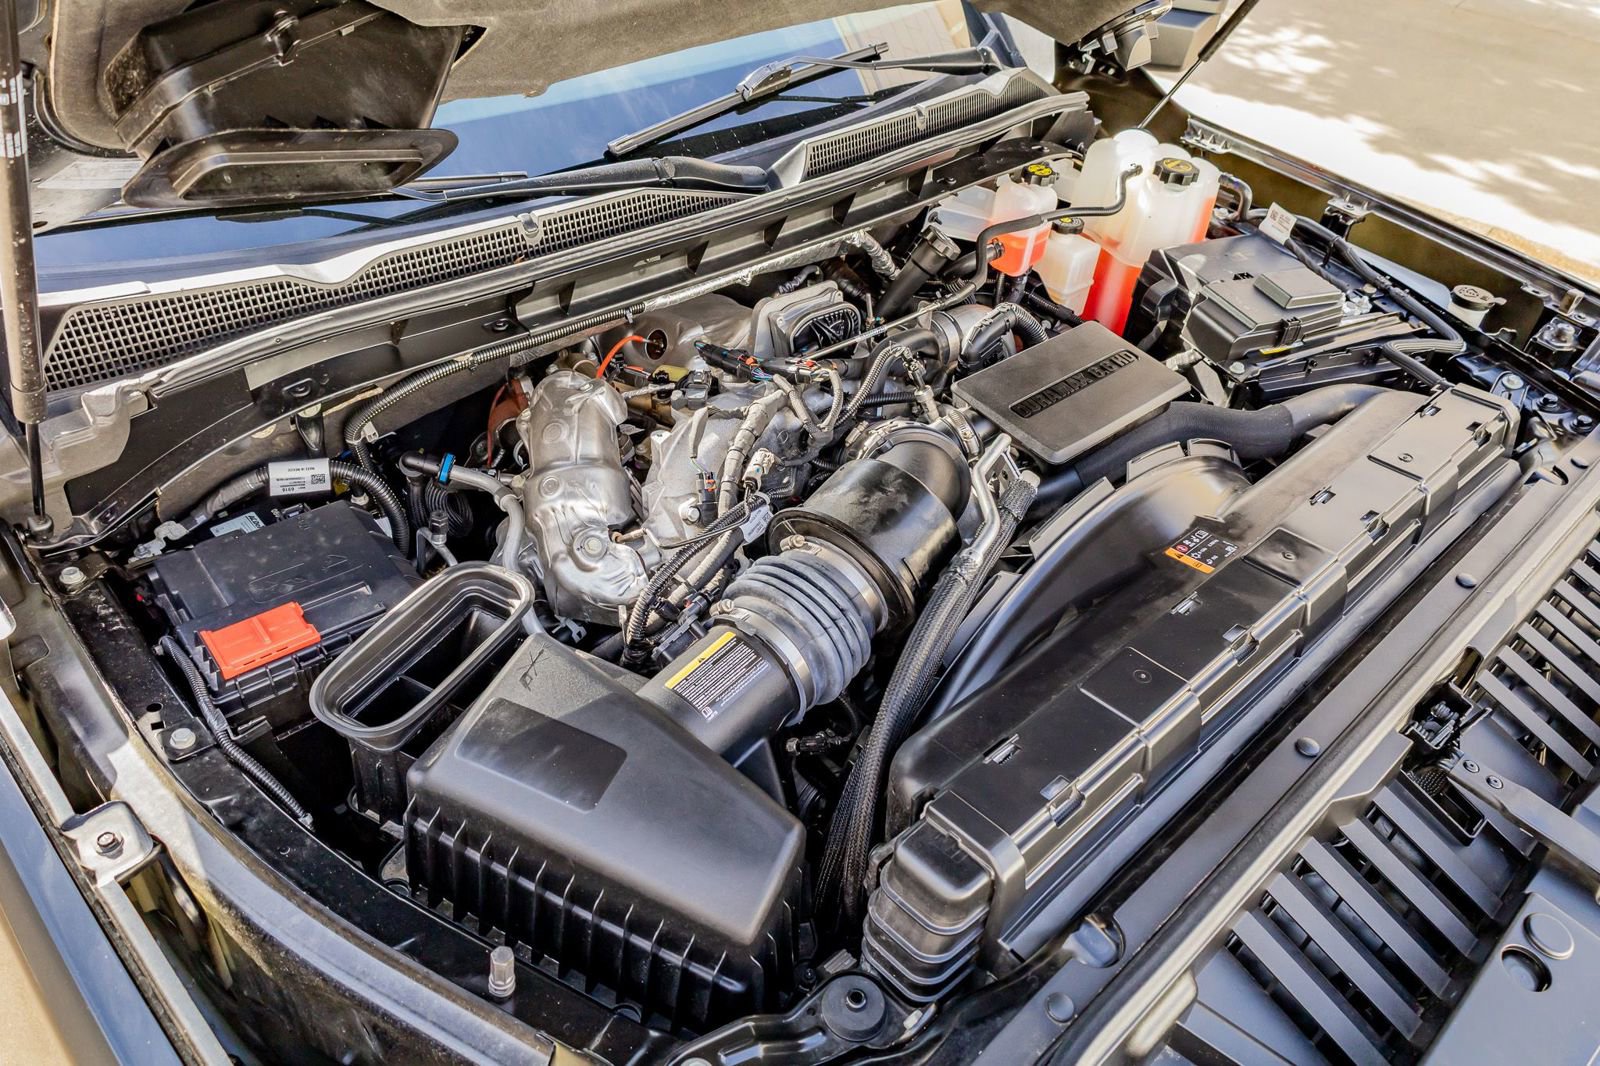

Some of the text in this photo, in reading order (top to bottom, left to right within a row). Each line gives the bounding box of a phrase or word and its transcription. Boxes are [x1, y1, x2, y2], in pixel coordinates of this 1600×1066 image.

[1014, 351, 1135, 417] DURAMAX 6.6 HD
